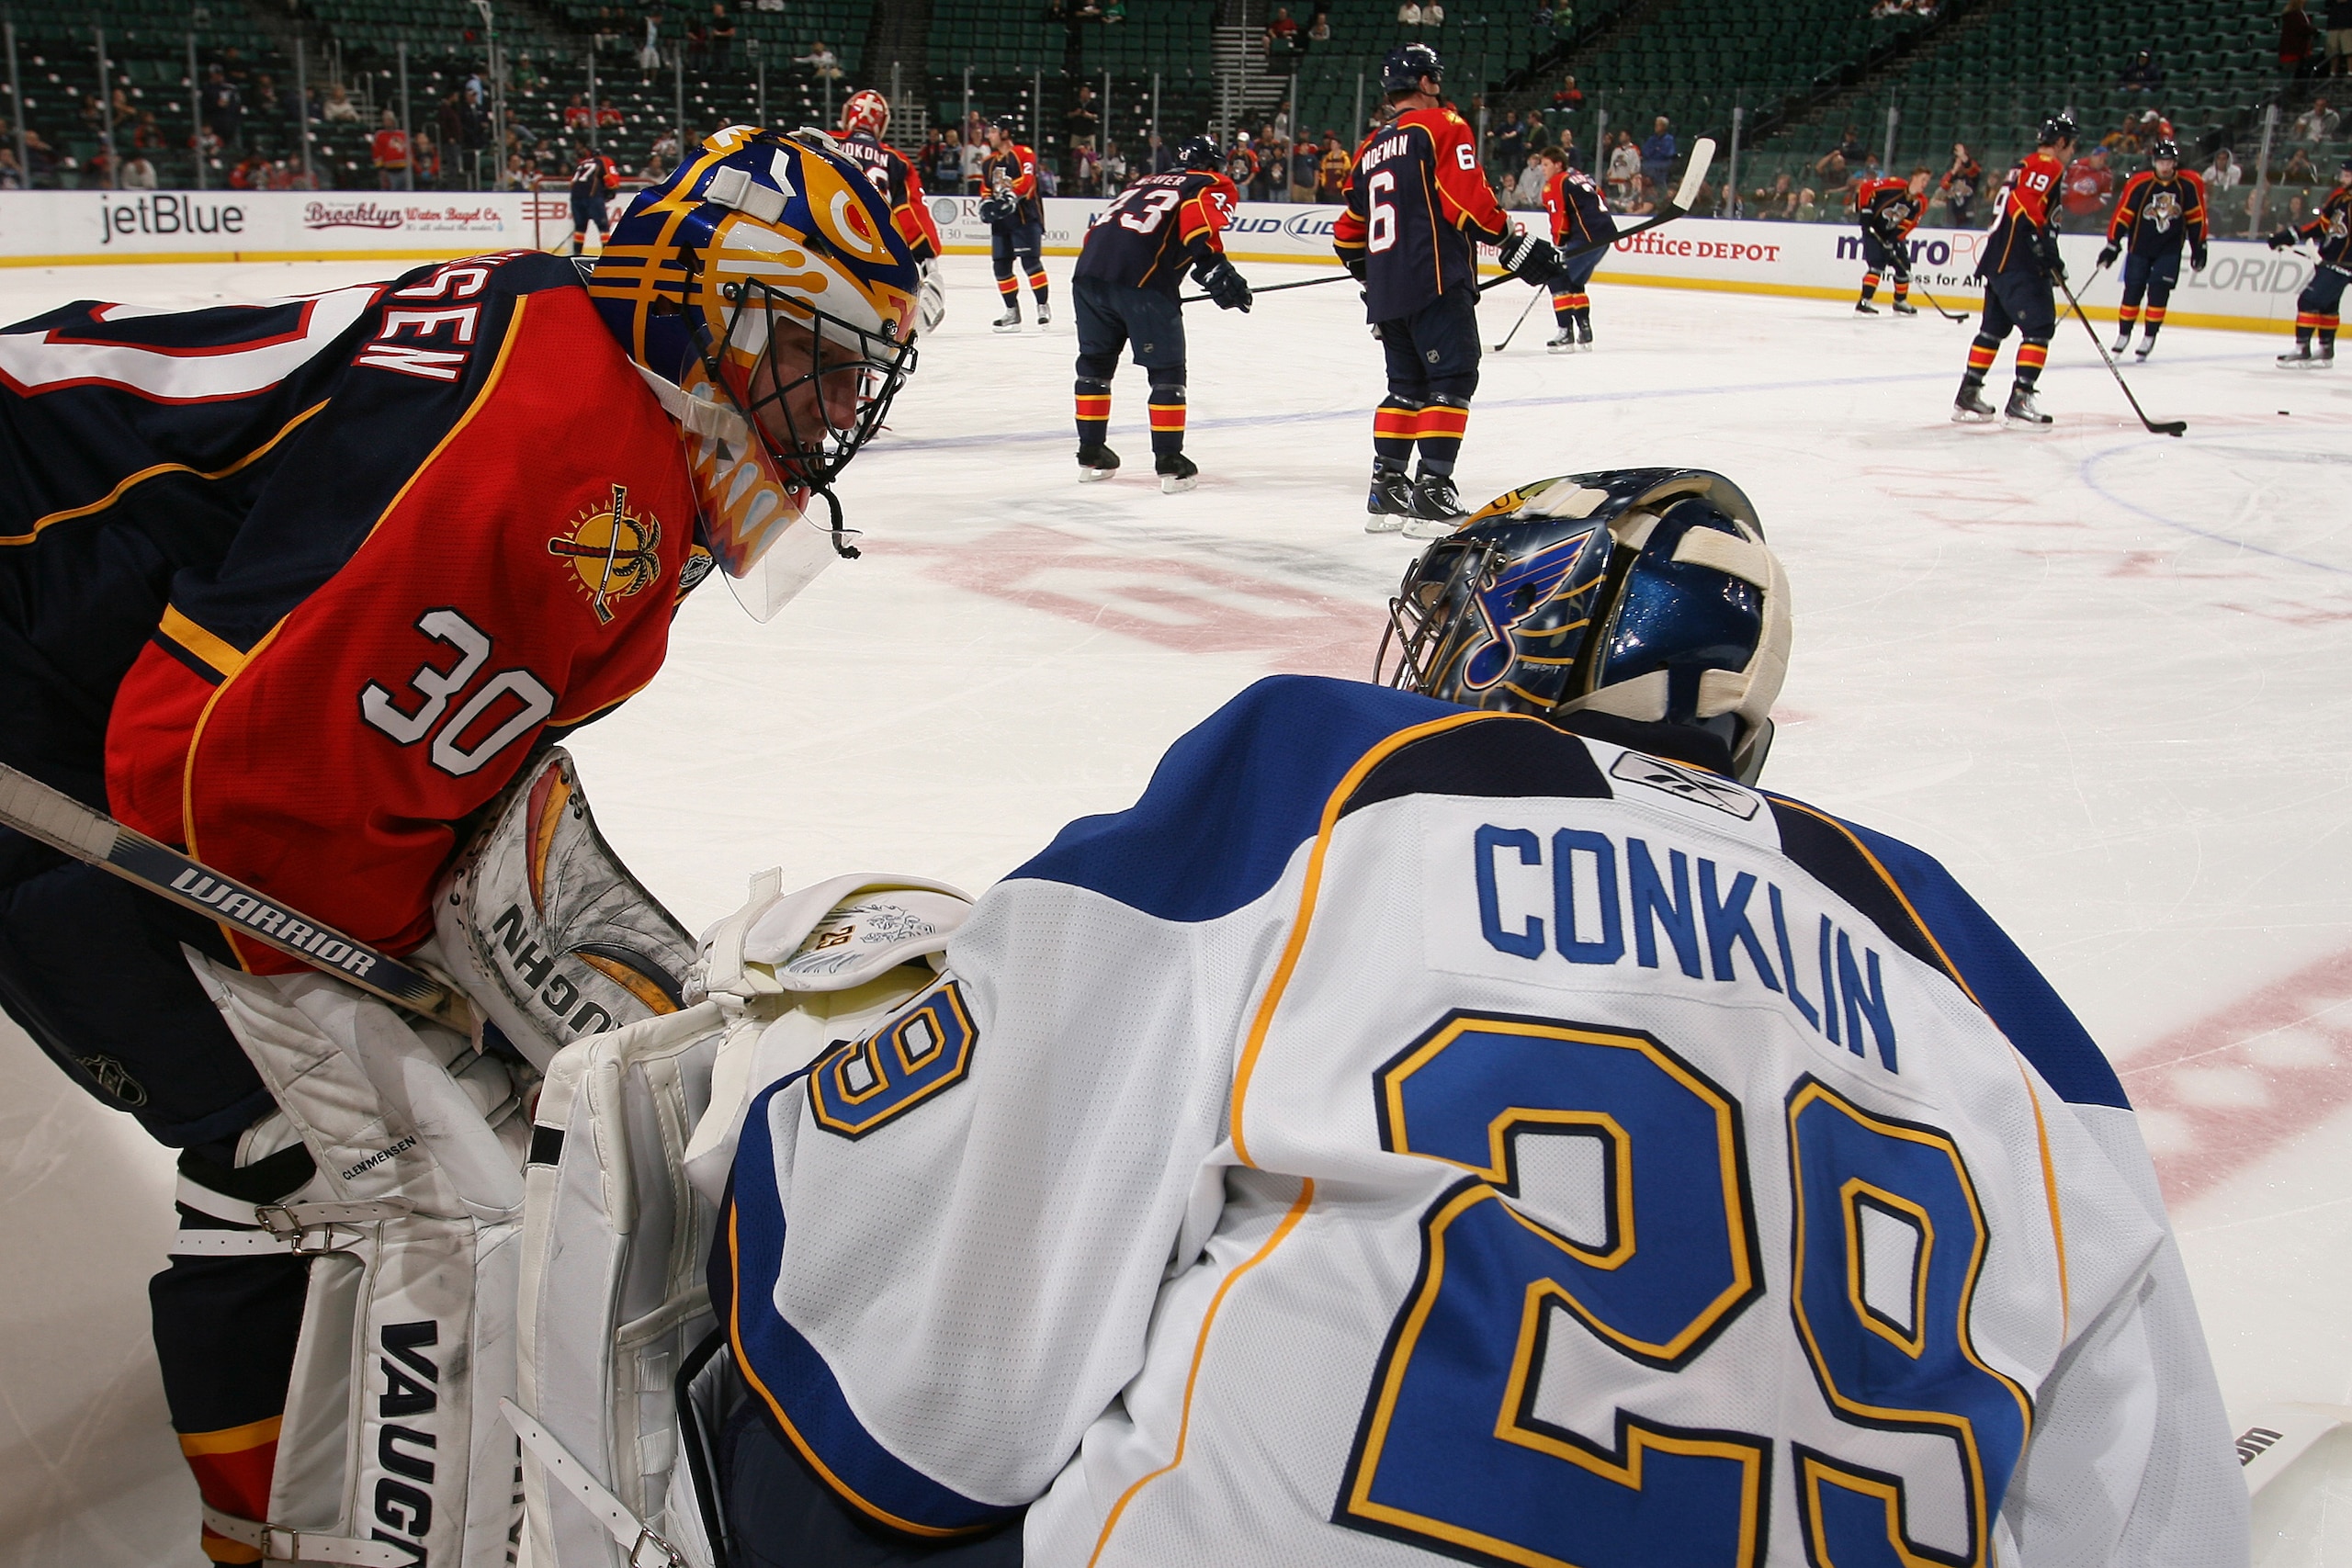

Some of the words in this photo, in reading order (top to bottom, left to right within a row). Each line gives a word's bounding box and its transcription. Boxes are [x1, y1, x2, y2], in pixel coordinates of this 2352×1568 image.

[1361, 134, 1408, 175] WIDEMAN
[1455, 143, 1476, 171] 6
[1135, 175, 1187, 186] WEAVER
[2025, 171, 2050, 193] 19
[101, 194, 243, 243] jetBlue
[304, 201, 403, 229] Brooklyn
[404, 208, 442, 220] Water
[1094, 187, 1181, 234] 43
[1367, 169, 1397, 254] 6
[1613, 231, 1691, 257] Office
[1697, 242, 1781, 262] DEPOT
[1936, 274, 1956, 287] for
[358, 604, 557, 777] 30
[170, 867, 377, 978] WARRIOR
[492, 903, 624, 1034] UGHN
[1474, 823, 1899, 1074] CONKLIN
[1330, 1008, 2034, 1568] 29
